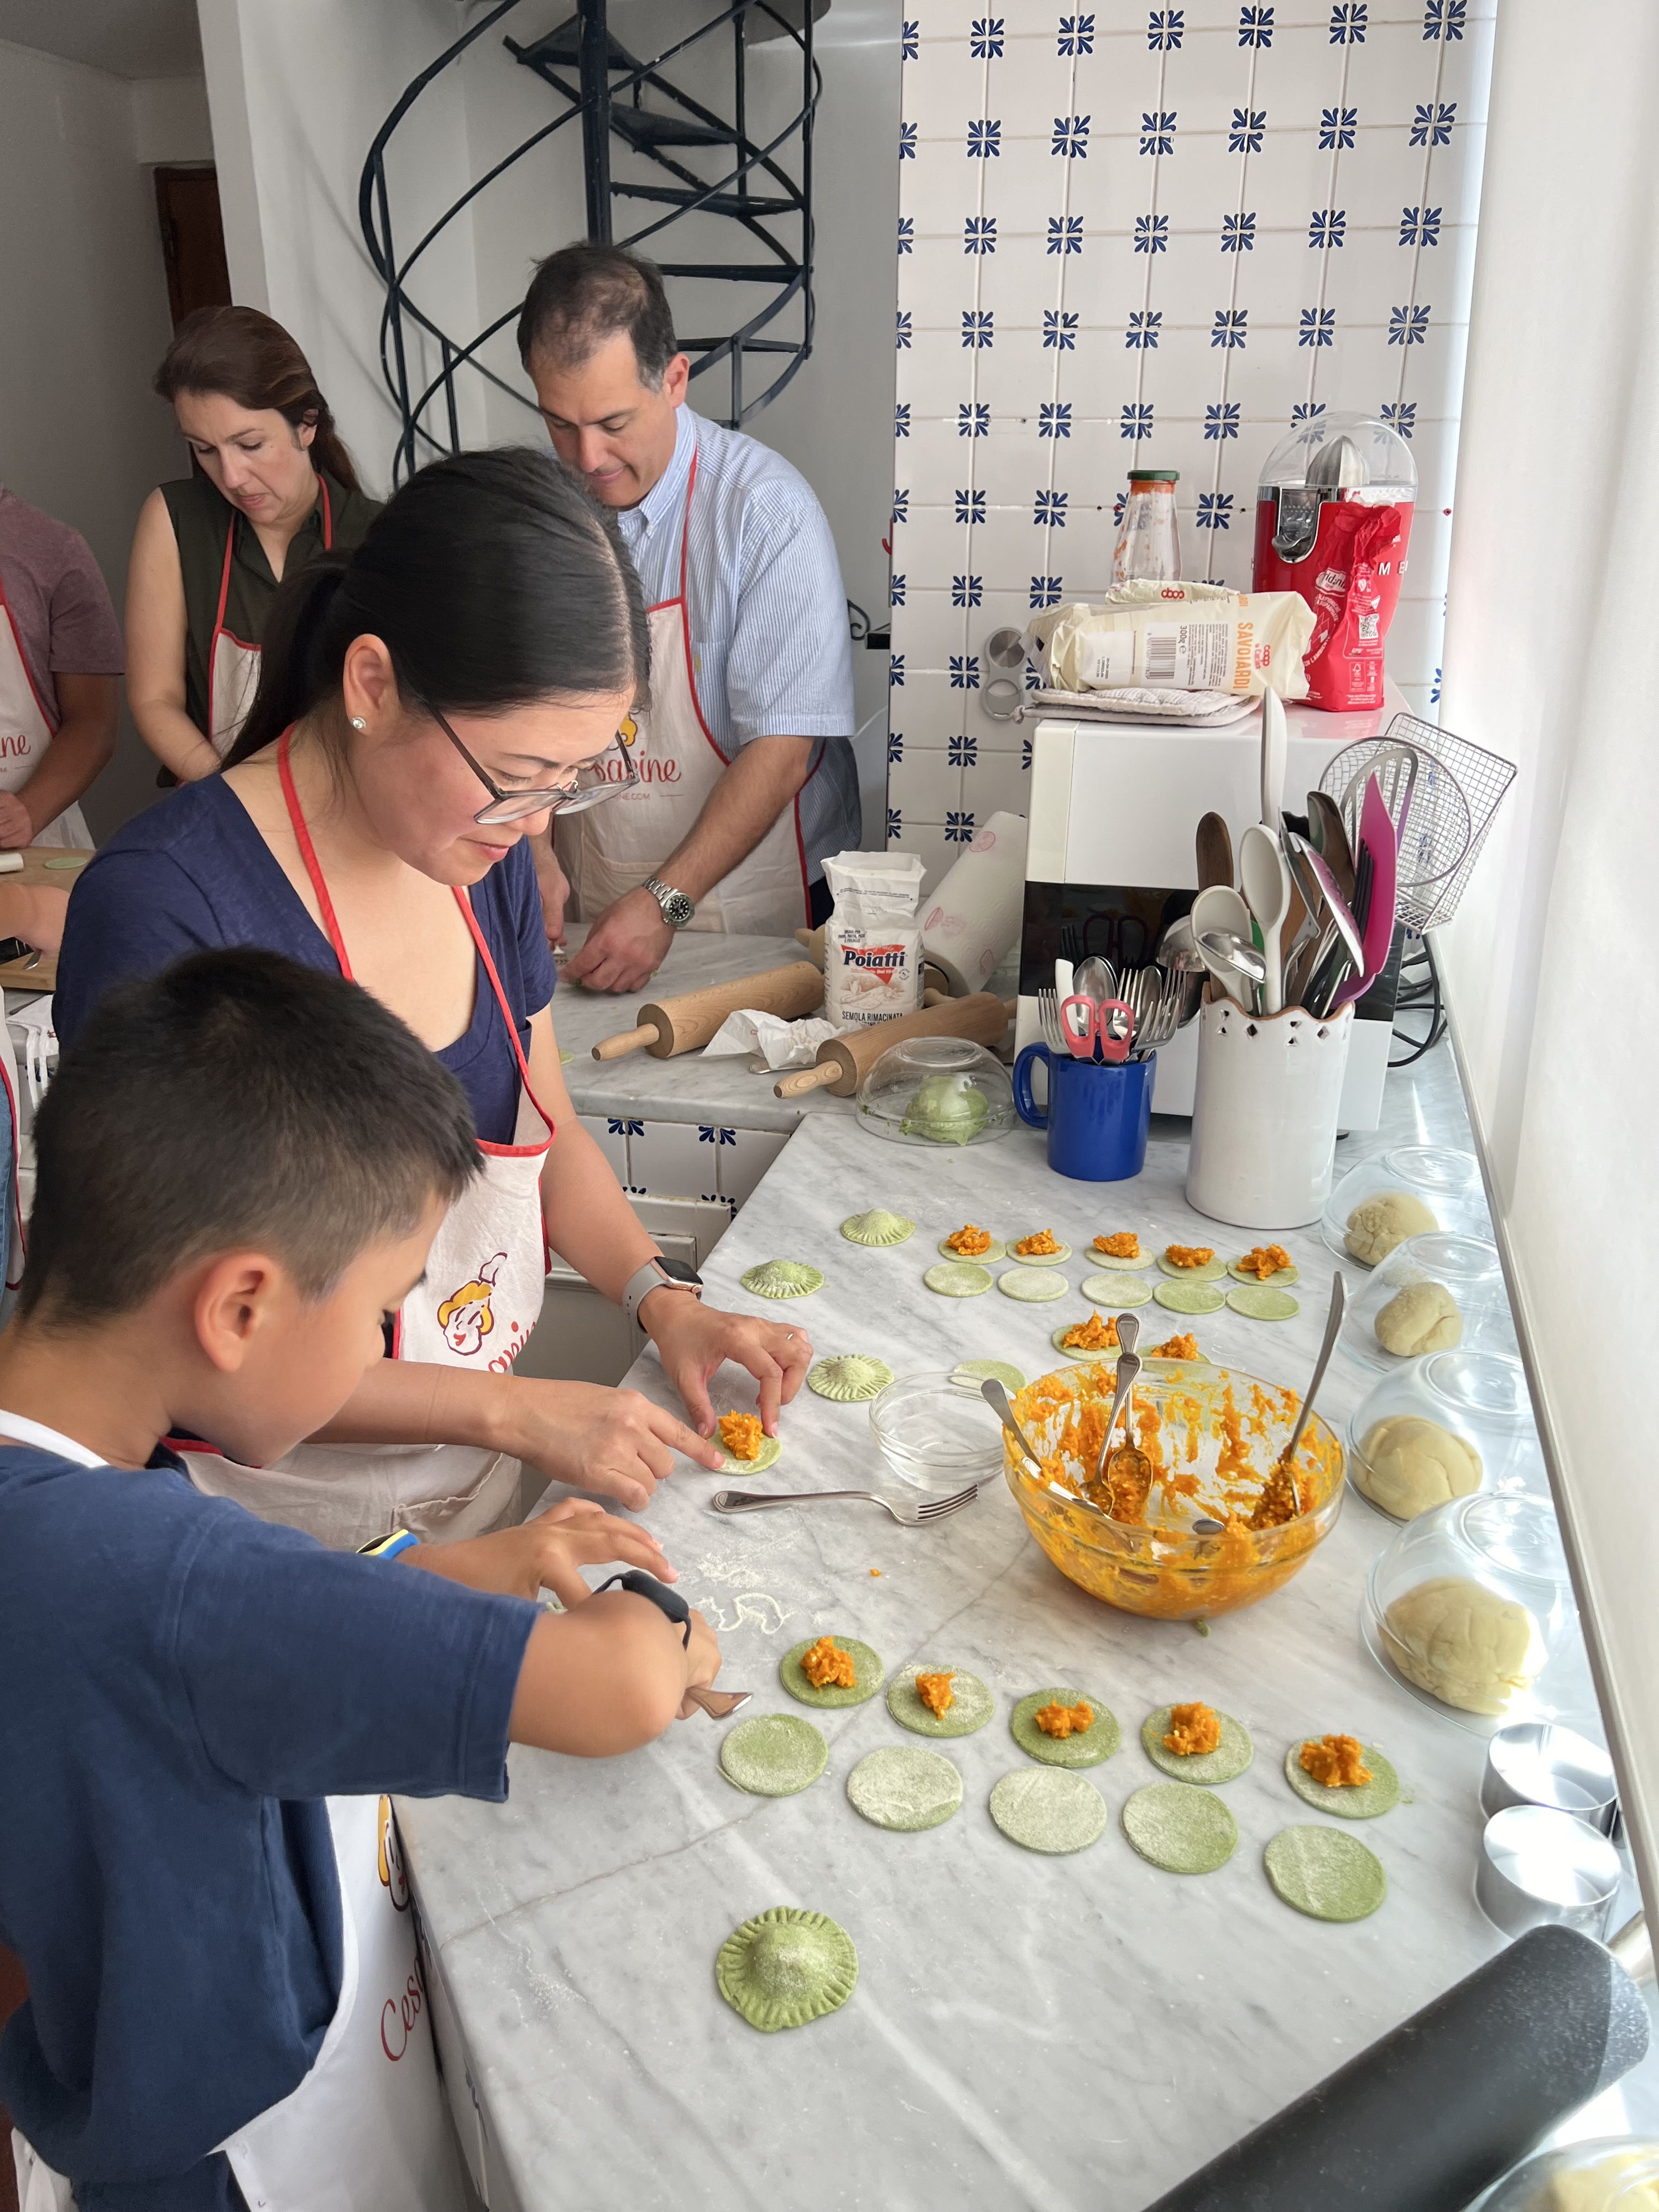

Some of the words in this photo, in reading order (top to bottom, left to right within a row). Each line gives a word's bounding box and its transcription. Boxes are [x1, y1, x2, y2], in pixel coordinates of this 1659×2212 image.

[1161, 587, 1185, 599] coop
[1178, 625, 1187, 644] 300g
[1233, 622, 1254, 689] SAVOIARDI
[1262, 644, 1271, 667] coop
[843, 950, 905, 967] Poiatti
[842, 1010, 865, 1021] SEMOLA
